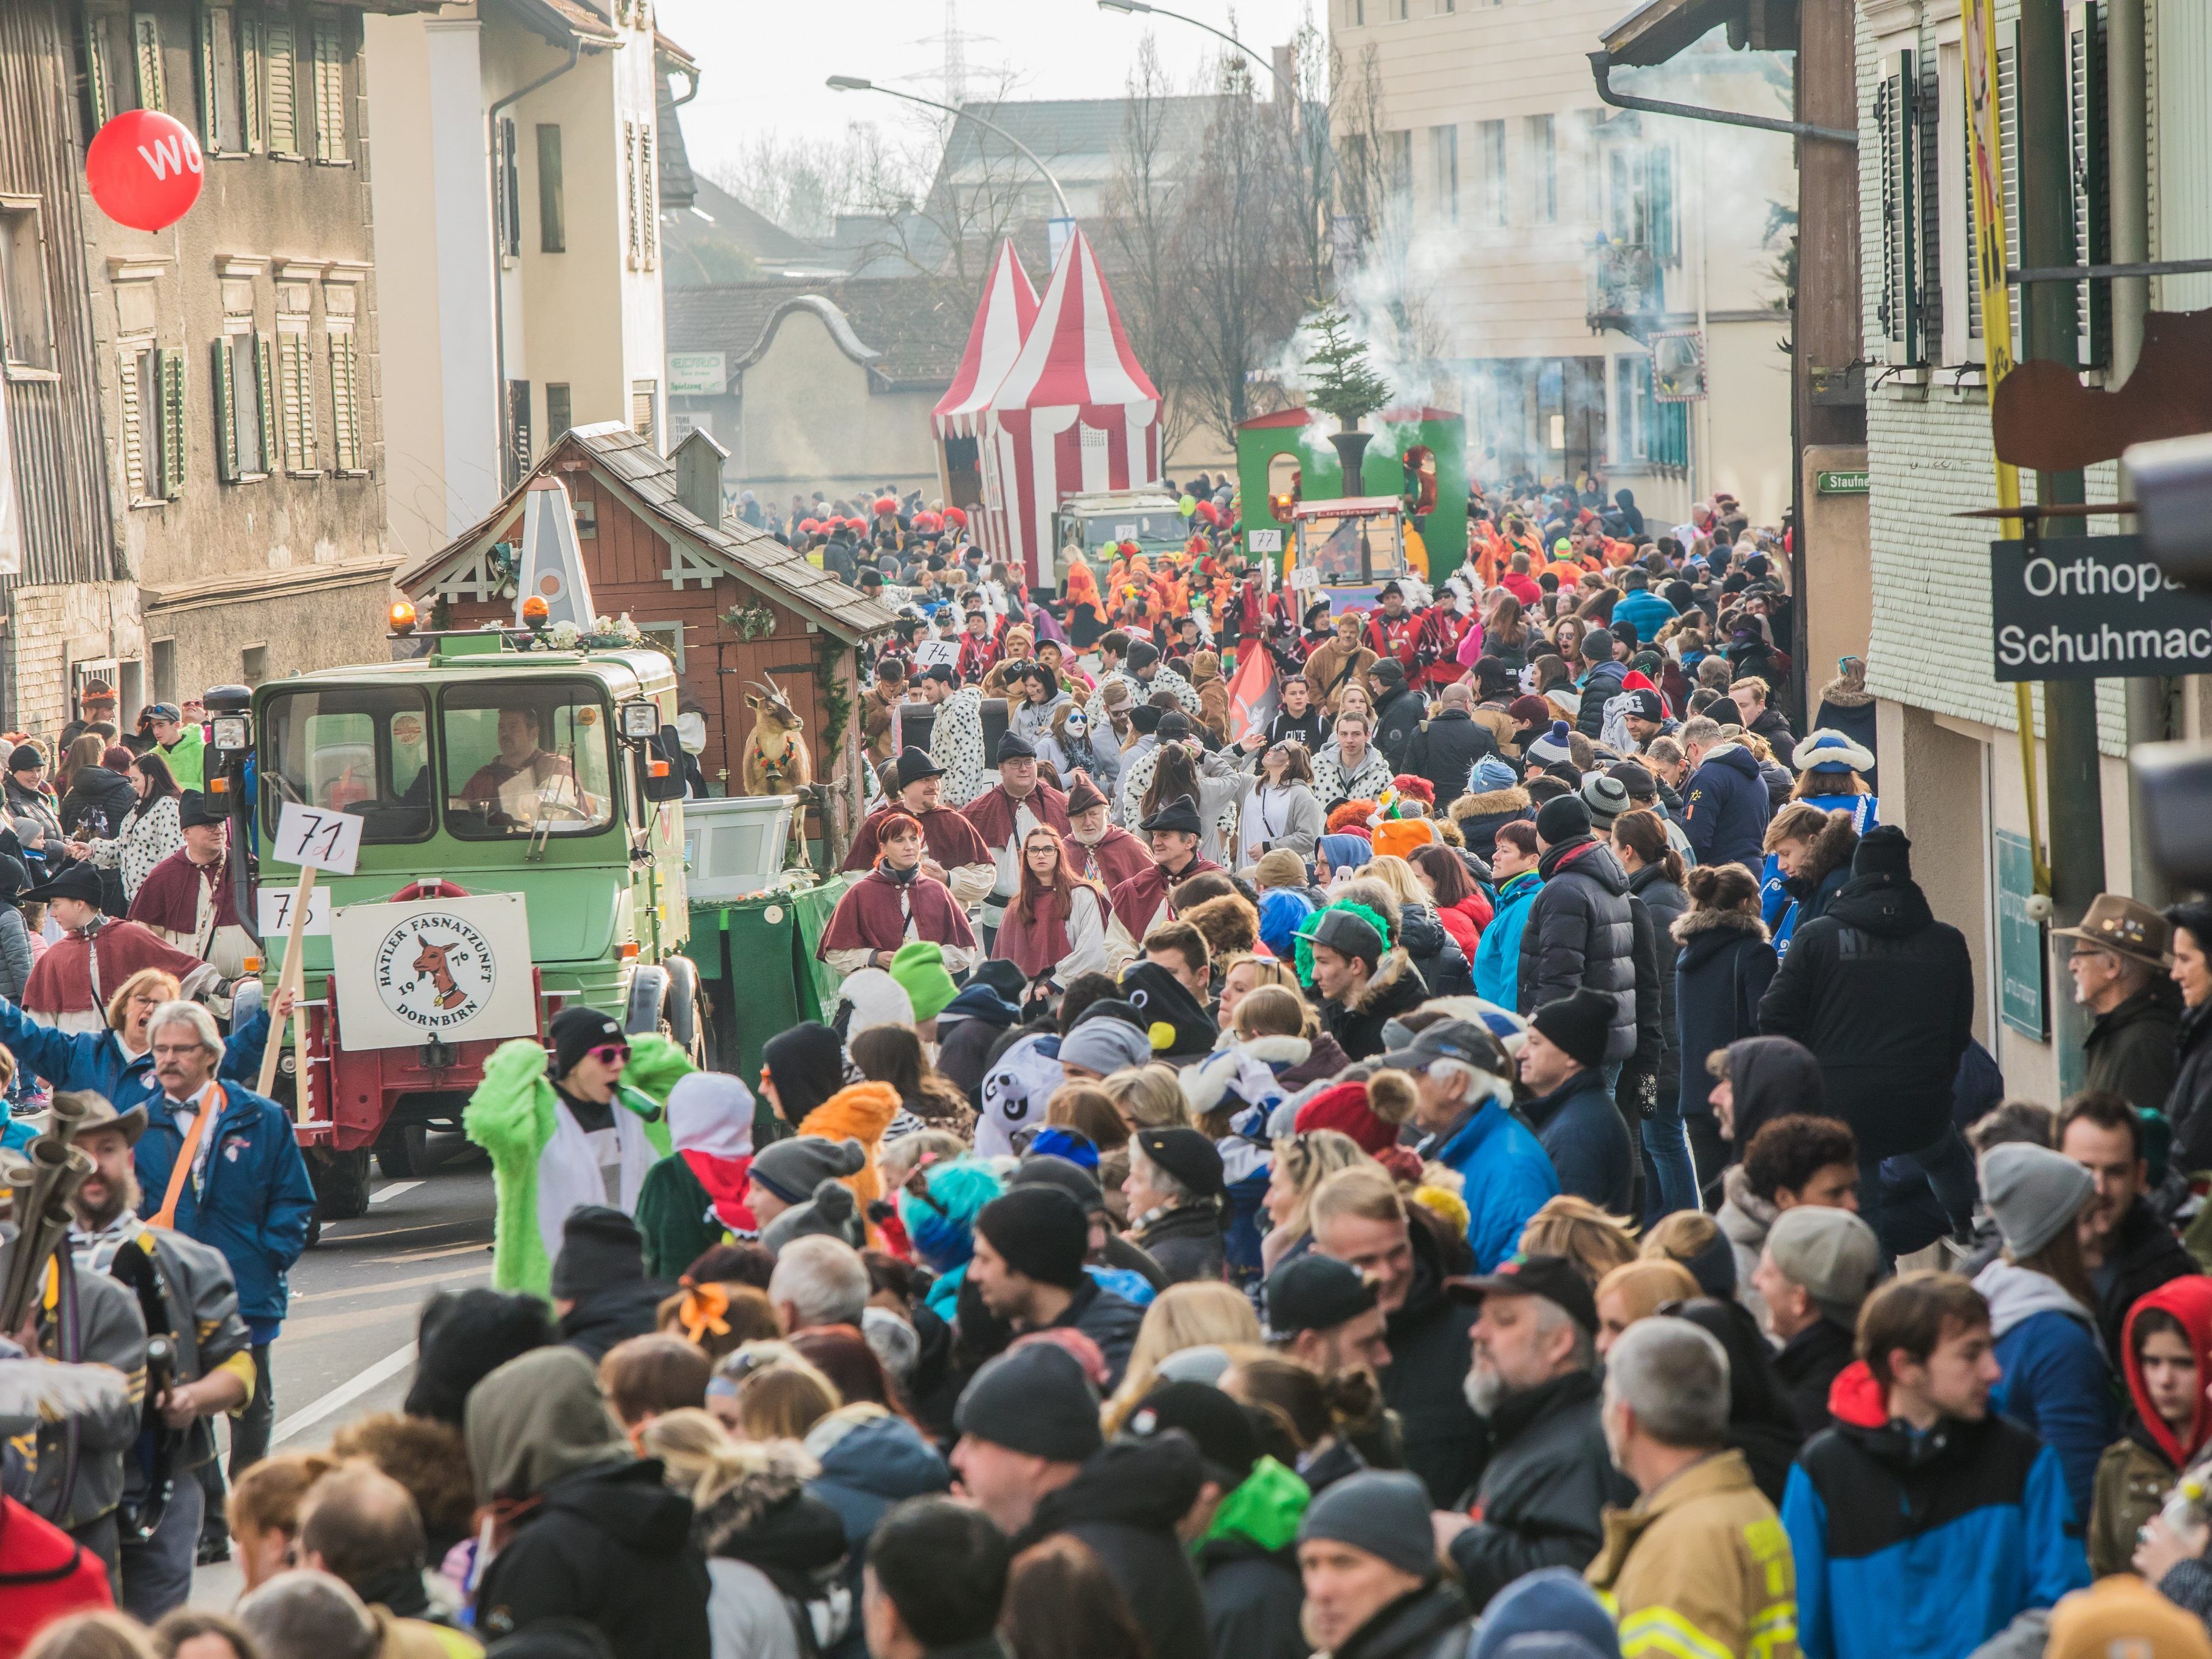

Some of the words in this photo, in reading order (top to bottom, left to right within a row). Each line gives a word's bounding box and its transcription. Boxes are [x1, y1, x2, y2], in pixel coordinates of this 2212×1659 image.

[1258, 532, 1274, 547] 77
[1296, 569, 1313, 585] 78
[929, 643, 950, 662] 74
[1999, 623, 2212, 665] Schuhmac
[380, 930, 407, 987] HATLER
[410, 917, 491, 983] FASNATZUNFT
[399, 982, 414, 996] 19
[451, 951, 469, 966] 76
[396, 1000, 478, 1026] DORNBIRN
